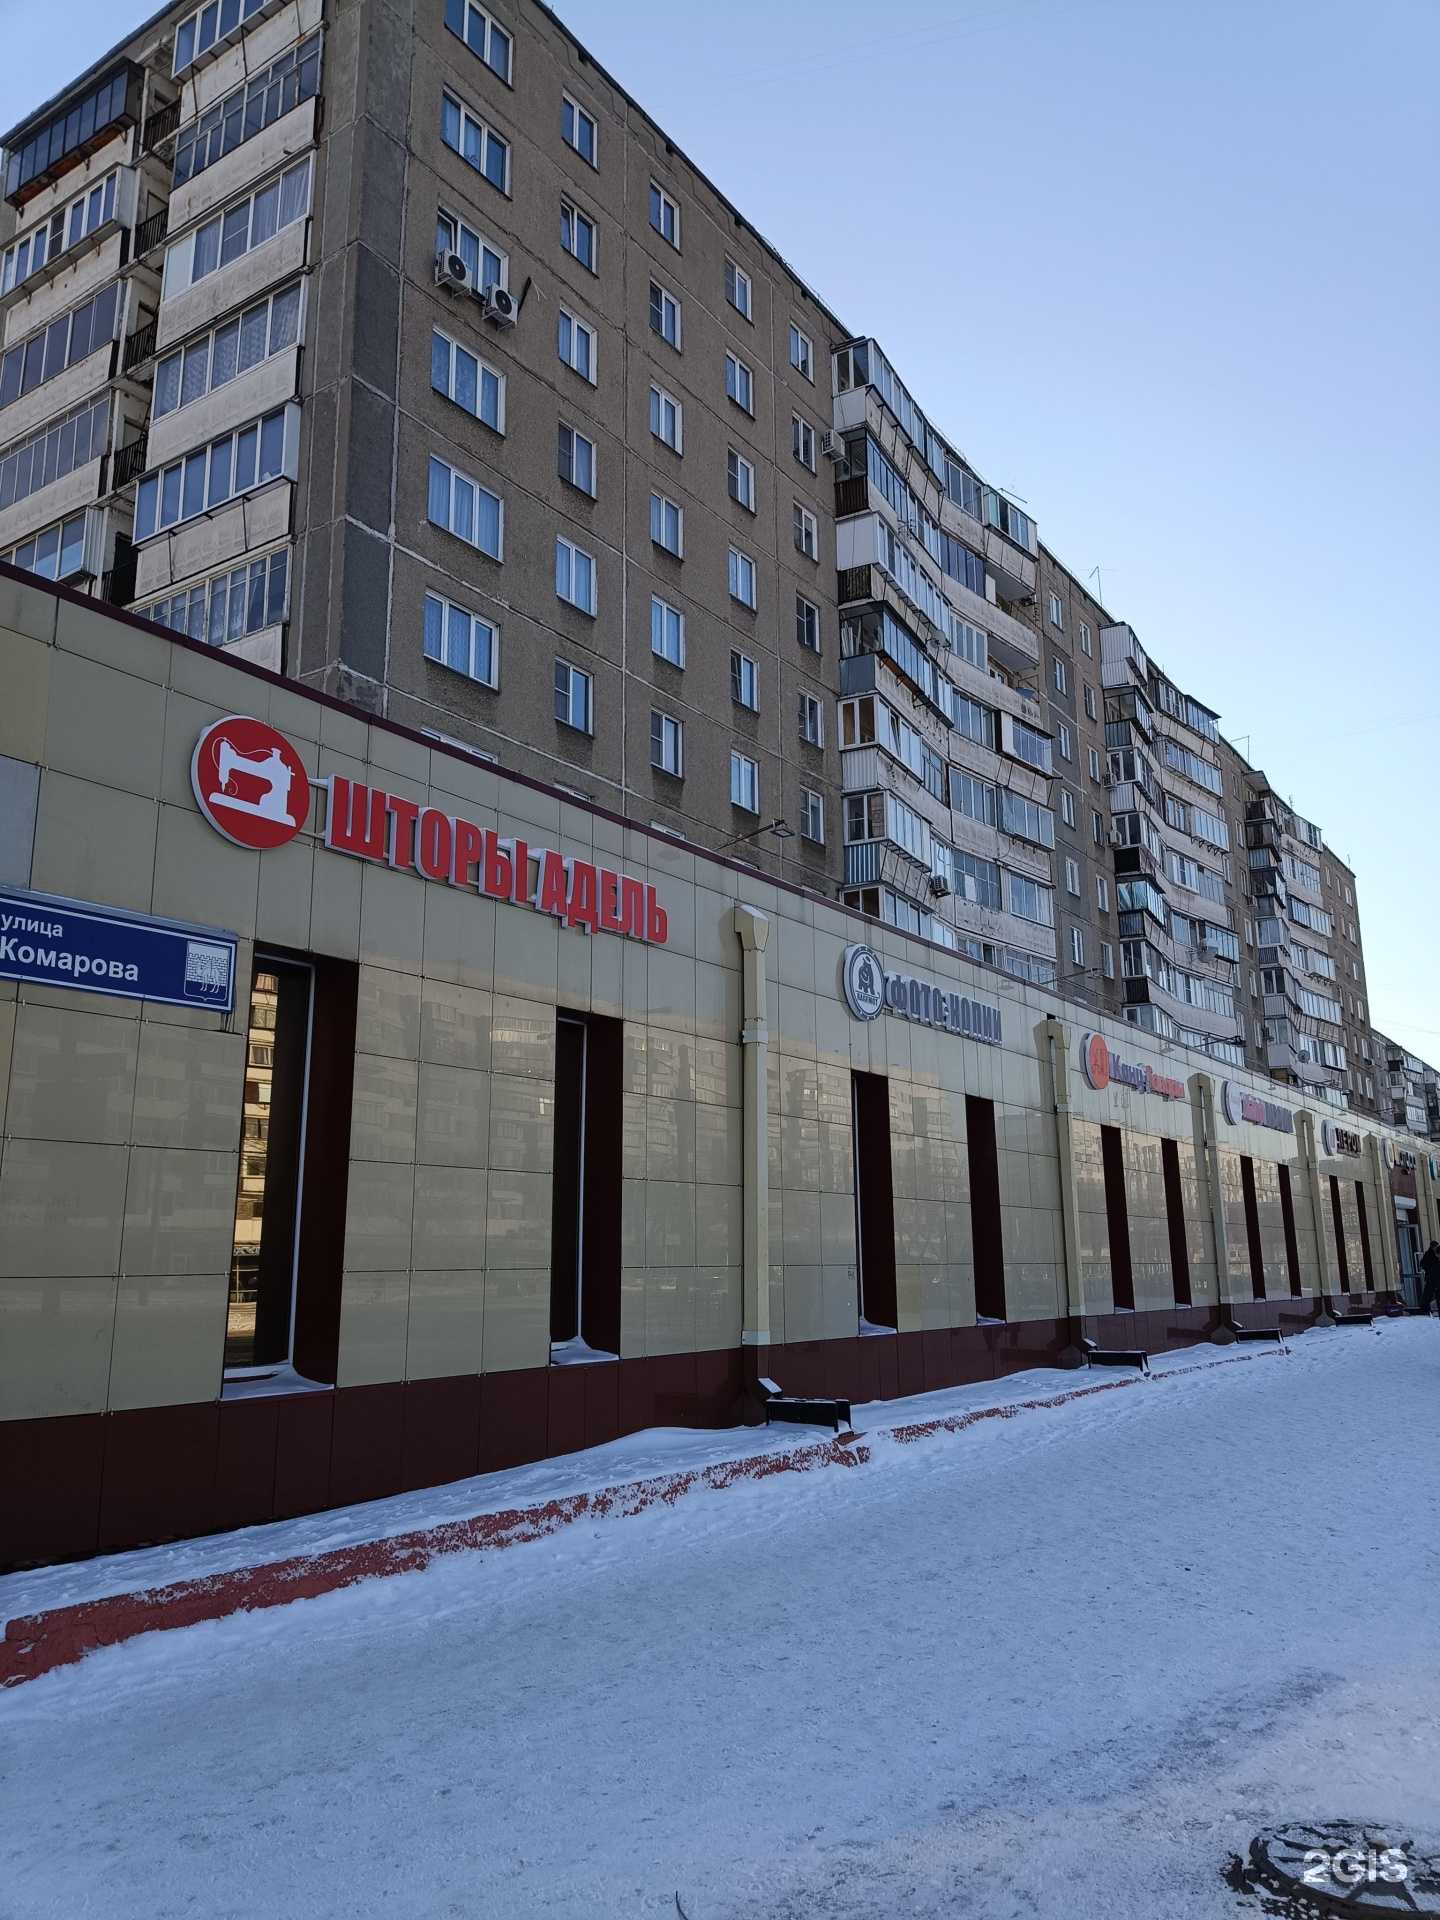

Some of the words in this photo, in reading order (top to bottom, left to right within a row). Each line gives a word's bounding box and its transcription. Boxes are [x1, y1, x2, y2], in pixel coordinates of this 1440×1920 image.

[325, 774, 529, 905] ШТОРЫ
[535, 848, 668, 945] АДЕЛЬ
[1, 913, 64, 938] улица
[0, 935, 139, 982] Комарова
